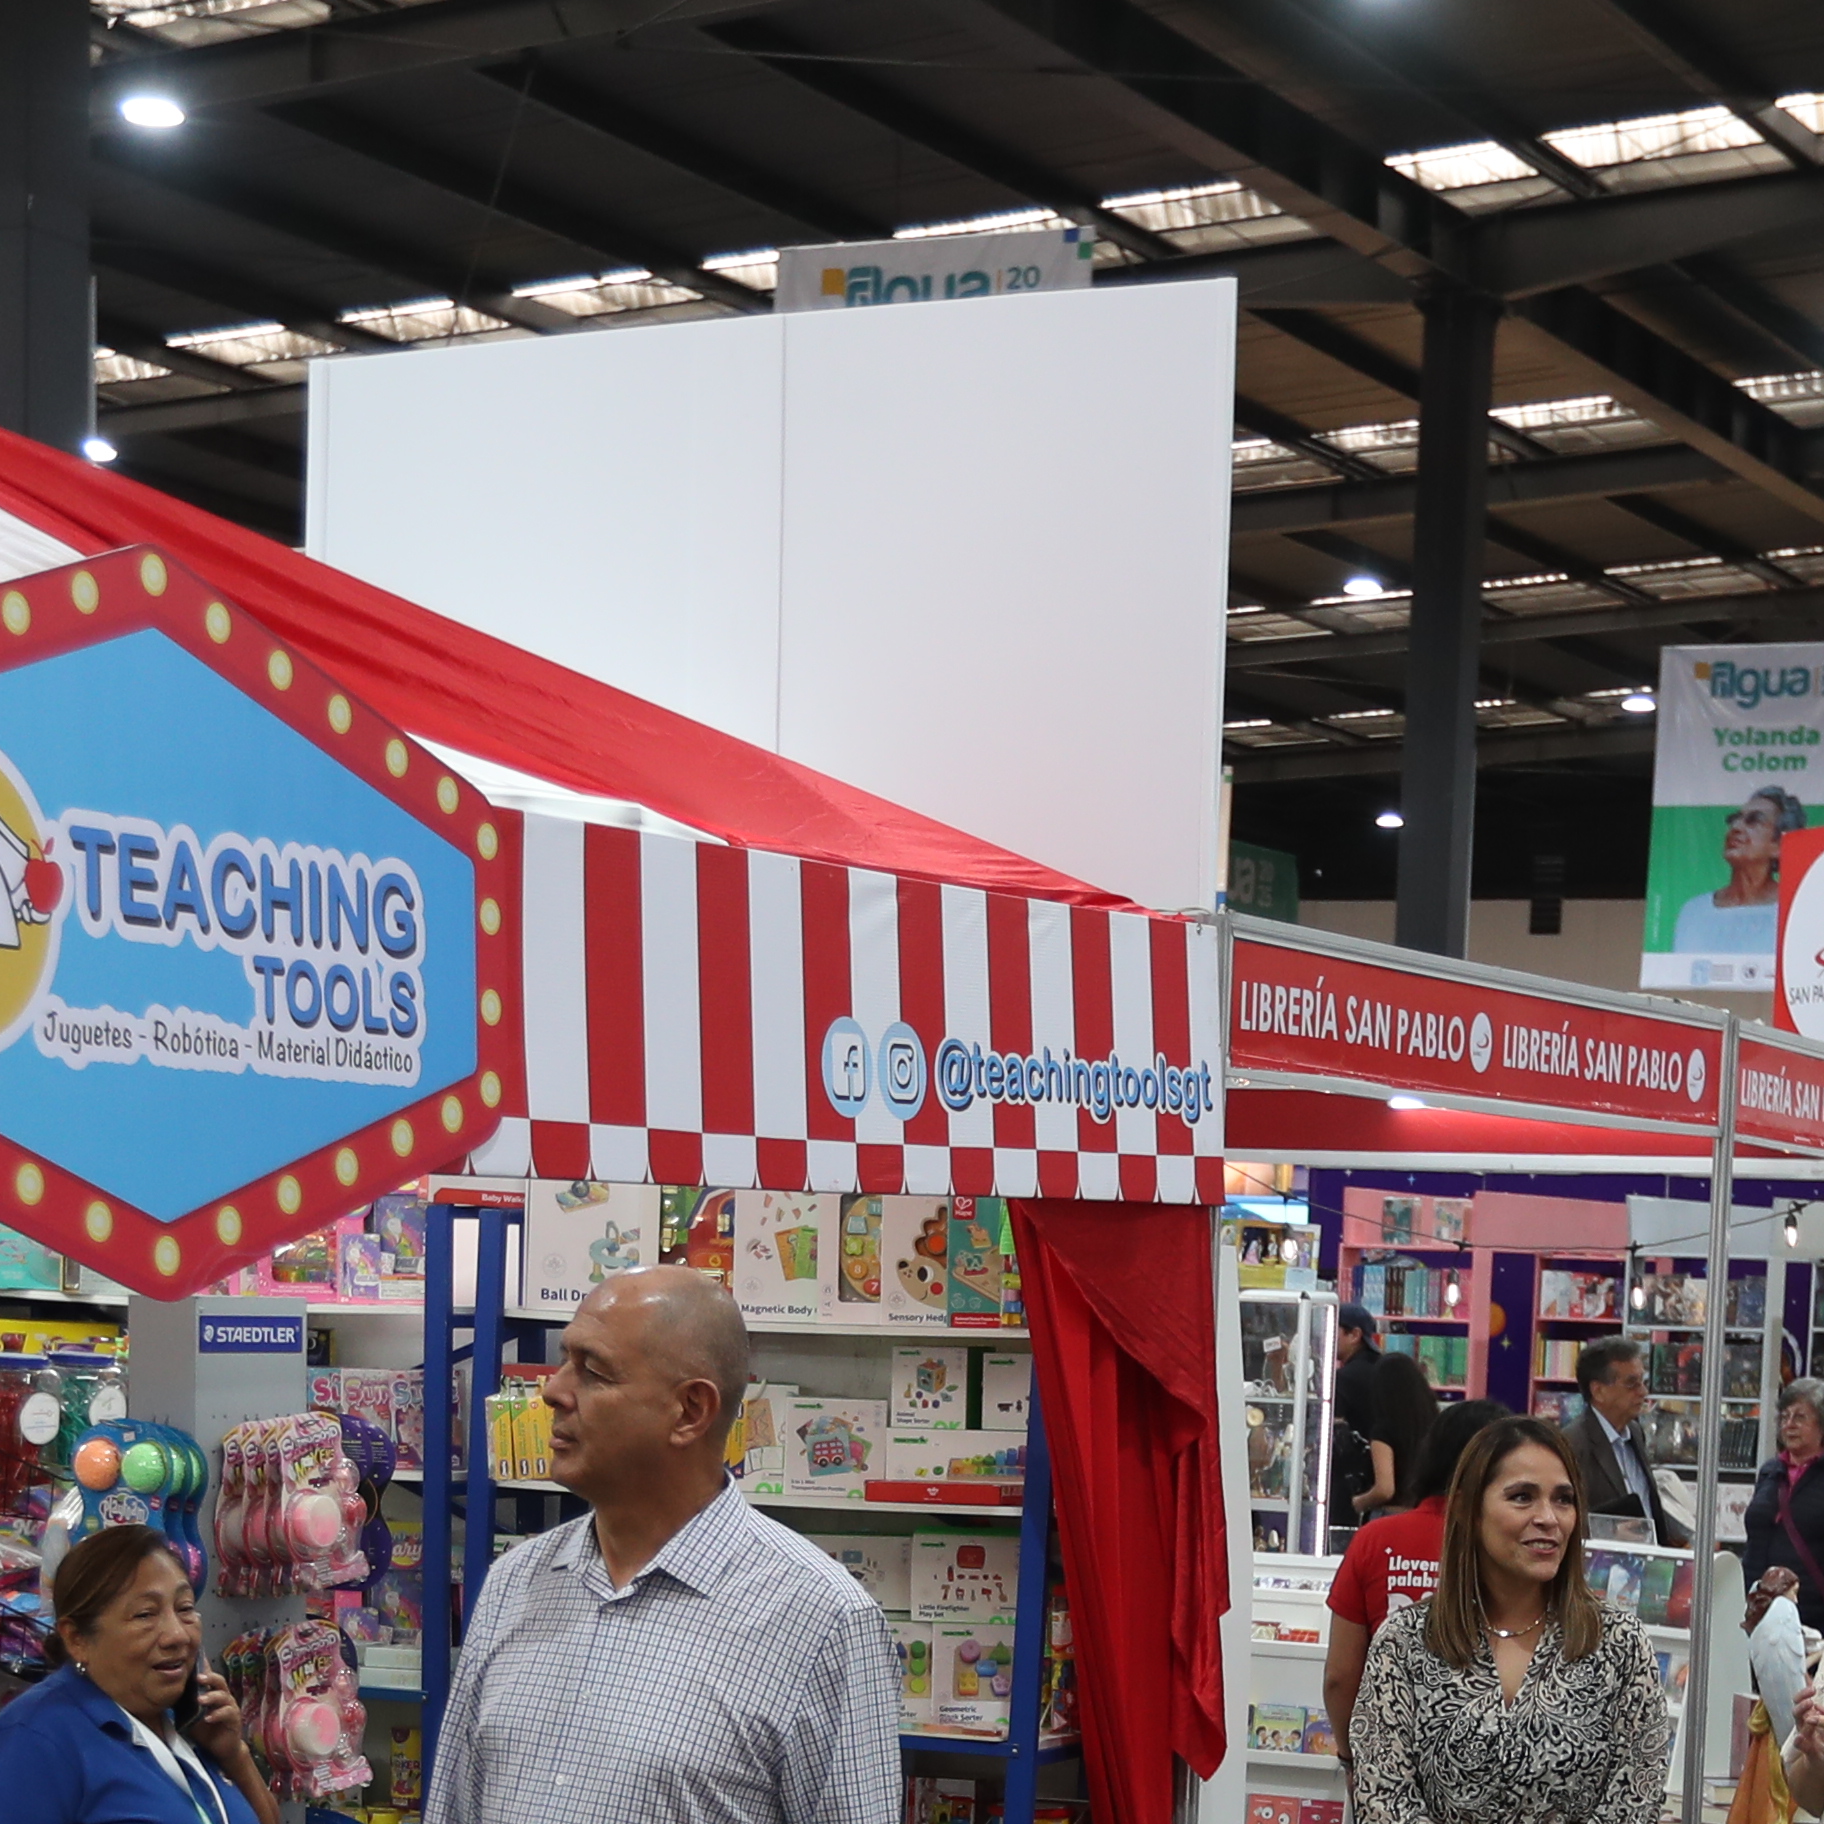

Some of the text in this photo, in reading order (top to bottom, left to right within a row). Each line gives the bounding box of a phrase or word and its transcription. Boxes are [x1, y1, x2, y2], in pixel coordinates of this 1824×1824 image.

[1007, 266, 1041, 290] 20
[1713, 725, 1821, 746] Yolanda
[1723, 752, 1807, 772] Colom
[69, 826, 418, 958] TEACHING
[254, 956, 418, 1037] TOOLS
[1789, 984, 1810, 1005] SAN
[44, 1010, 413, 1074] Juguetes Robótica Material Didáctico
[1240, 976, 1681, 1093] LIBRERÍA SAN PABLO LIBRERÍA SAN PABLO
[939, 1037, 1213, 1123] @teachingtoolsgt
[1740, 1066, 1792, 1117] LIBRERÍA
[1794, 1081, 1819, 1120] SAN
[541, 1288, 587, 1301] Ball Dr
[741, 1304, 813, 1317] Magnetic Body
[889, 1312, 924, 1323] Sensory
[216, 1327, 296, 1344] STAEDTLER
